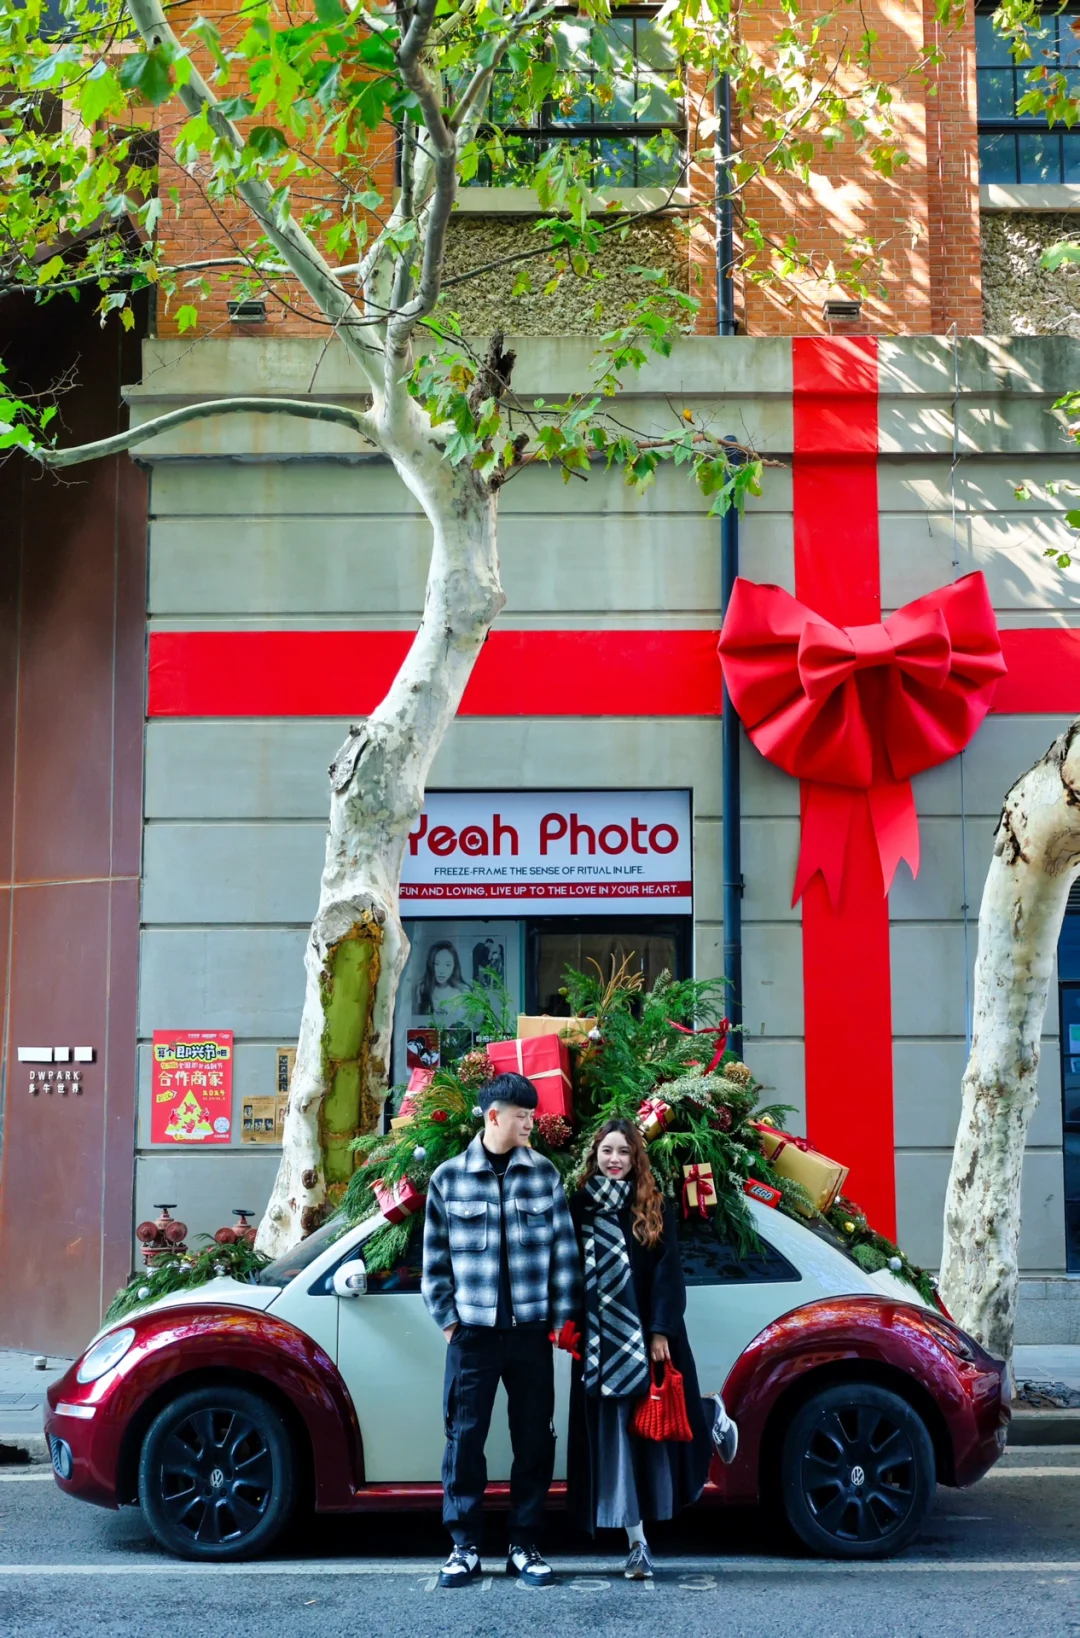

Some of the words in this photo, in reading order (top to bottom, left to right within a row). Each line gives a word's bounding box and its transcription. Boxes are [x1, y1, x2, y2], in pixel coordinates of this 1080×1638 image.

[408, 814, 519, 857] Yeah
[539, 812, 679, 856] Photo
[434, 867, 507, 876] FREEZE-FRAME
[510, 867, 528, 875] THE
[529, 866, 560, 875] SENSE
[562, 866, 576, 875] OF
[577, 866, 611, 875] RITUAL
[613, 866, 623, 874] IN
[623, 865, 645, 874] LIFE.
[400, 887, 419, 896] FUN
[421, 887, 444, 896] AND
[446, 886, 488, 897] LOVING,
[490, 886, 511, 896] LIVE
[513, 886, 527, 895] UP
[529, 886, 546, 895] TO
[548, 886, 567, 895] THE
[569, 885, 597, 895] LOVE
[599, 885, 609, 894] IN
[611, 885, 640, 894] YOUR
[642, 884, 680, 894] HEART.
[29, 1071, 80, 1080] DWPARK
[158, 1070, 224, 1087] 合作商家
[751, 1185, 774, 1201] LEGO
